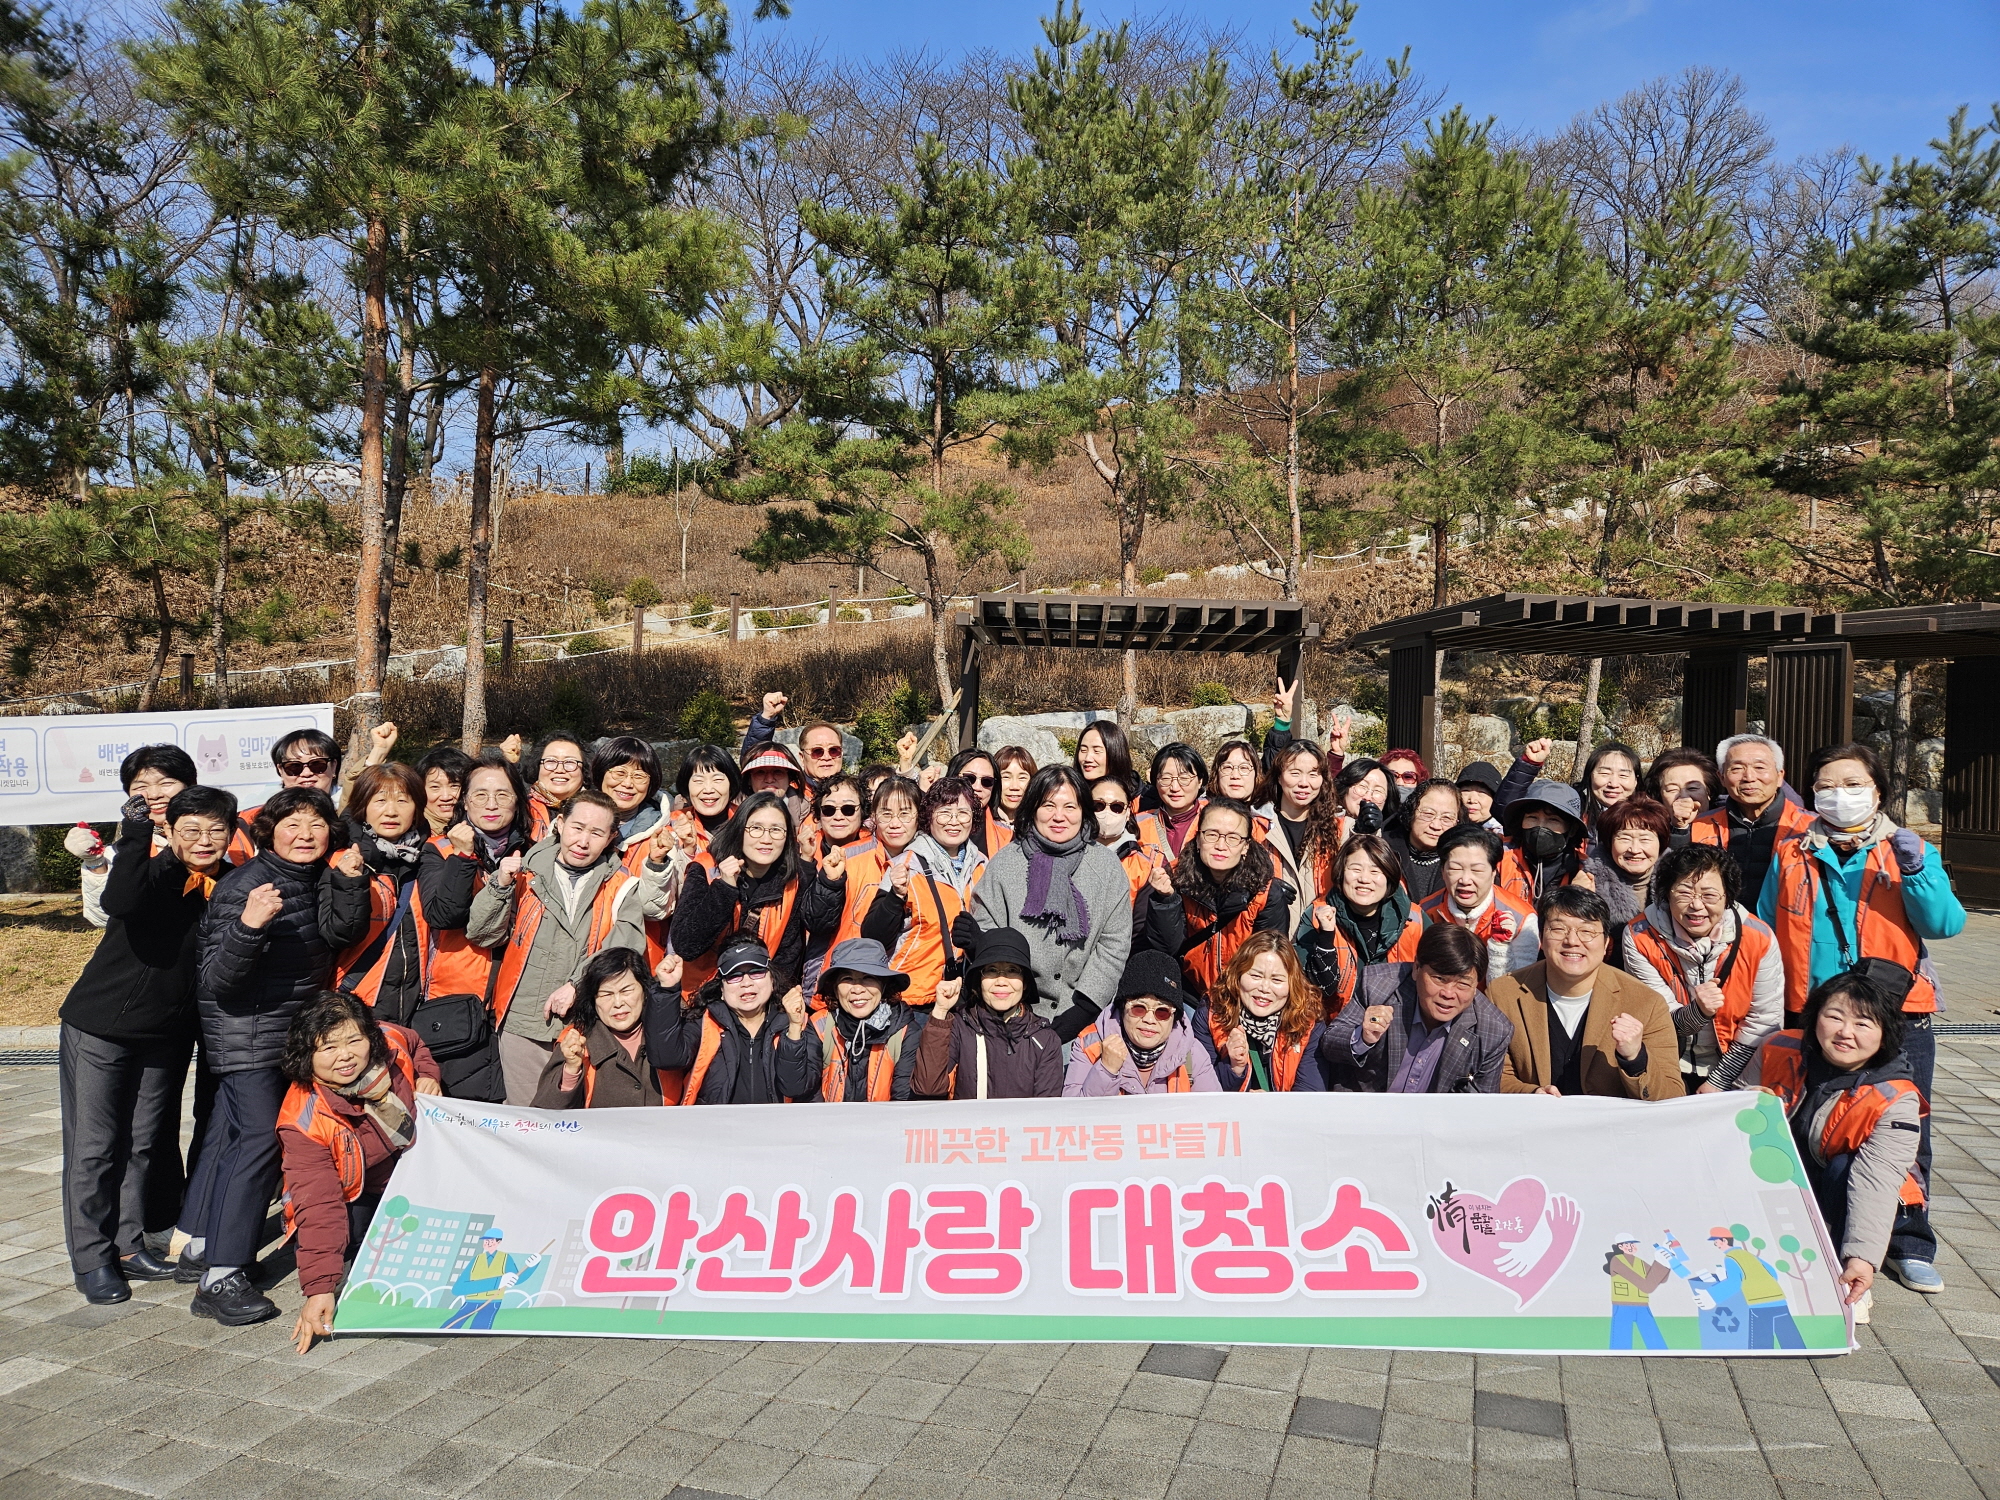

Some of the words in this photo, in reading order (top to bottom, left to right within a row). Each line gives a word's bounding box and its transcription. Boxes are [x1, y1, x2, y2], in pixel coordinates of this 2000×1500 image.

[0, 779, 29, 788] 켓입니다
[554, 1120, 583, 1133] 안산
[904, 1127, 1010, 1164] 깨끗한
[1021, 1125, 1124, 1162] 고잔동
[1137, 1121, 1242, 1160] 만들기
[1427, 1181, 1470, 1254] 情
[1494, 1216, 1524, 1233] 고잔동
[580, 1186, 1036, 1295] 안산사랑
[1068, 1182, 1420, 1295] 대청소
